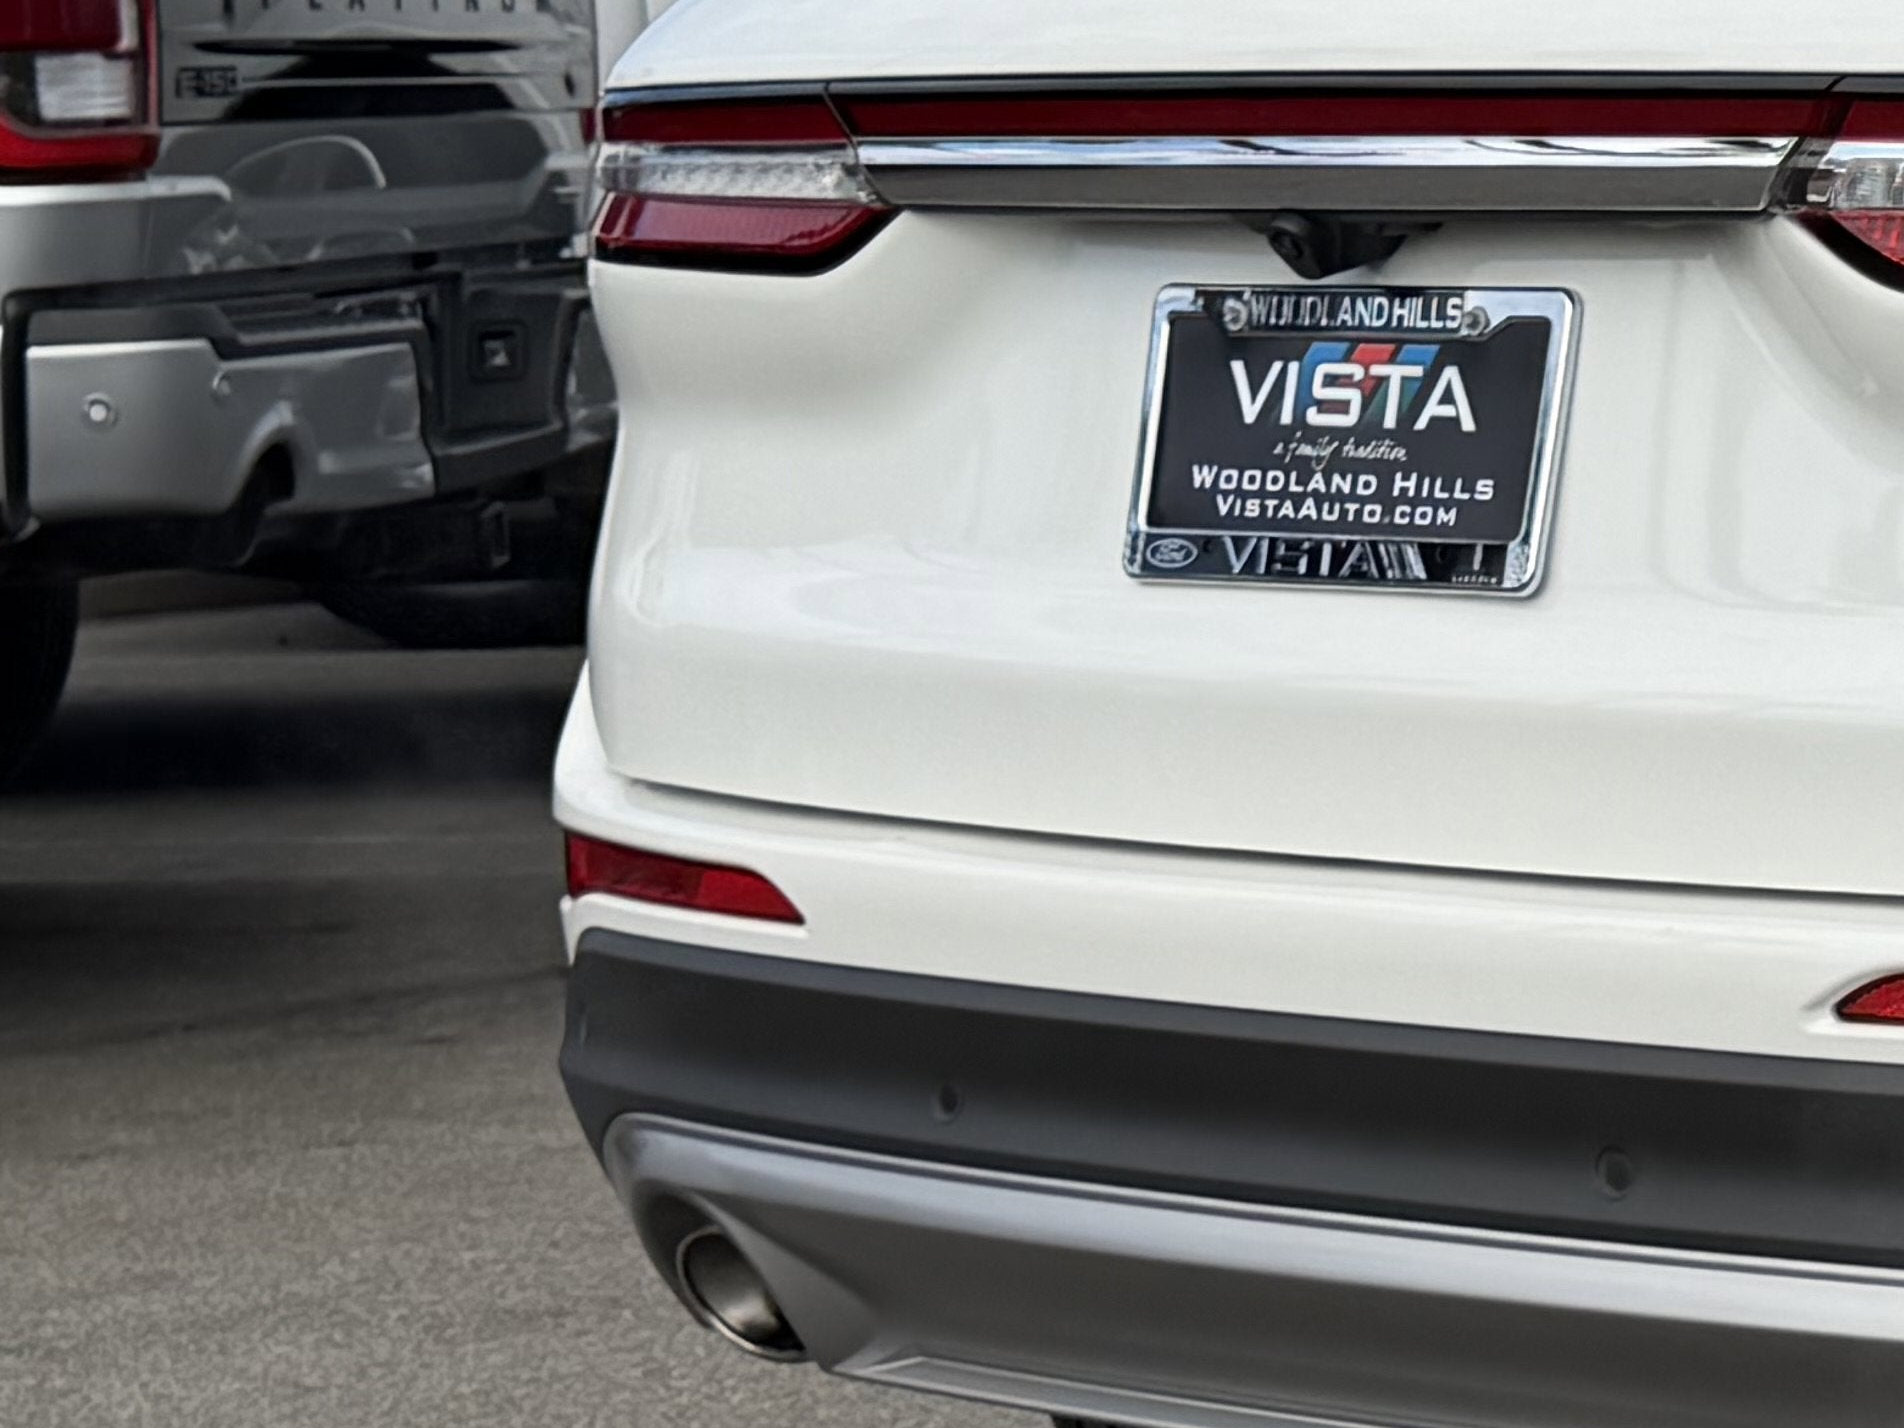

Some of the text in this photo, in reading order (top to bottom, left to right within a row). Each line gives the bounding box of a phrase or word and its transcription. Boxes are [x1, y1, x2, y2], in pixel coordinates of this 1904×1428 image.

[1390, 296, 1462, 328] HILLS
[1229, 359, 1476, 432] VISTA
[1192, 464, 1495, 501] WOODLAND HILLS
